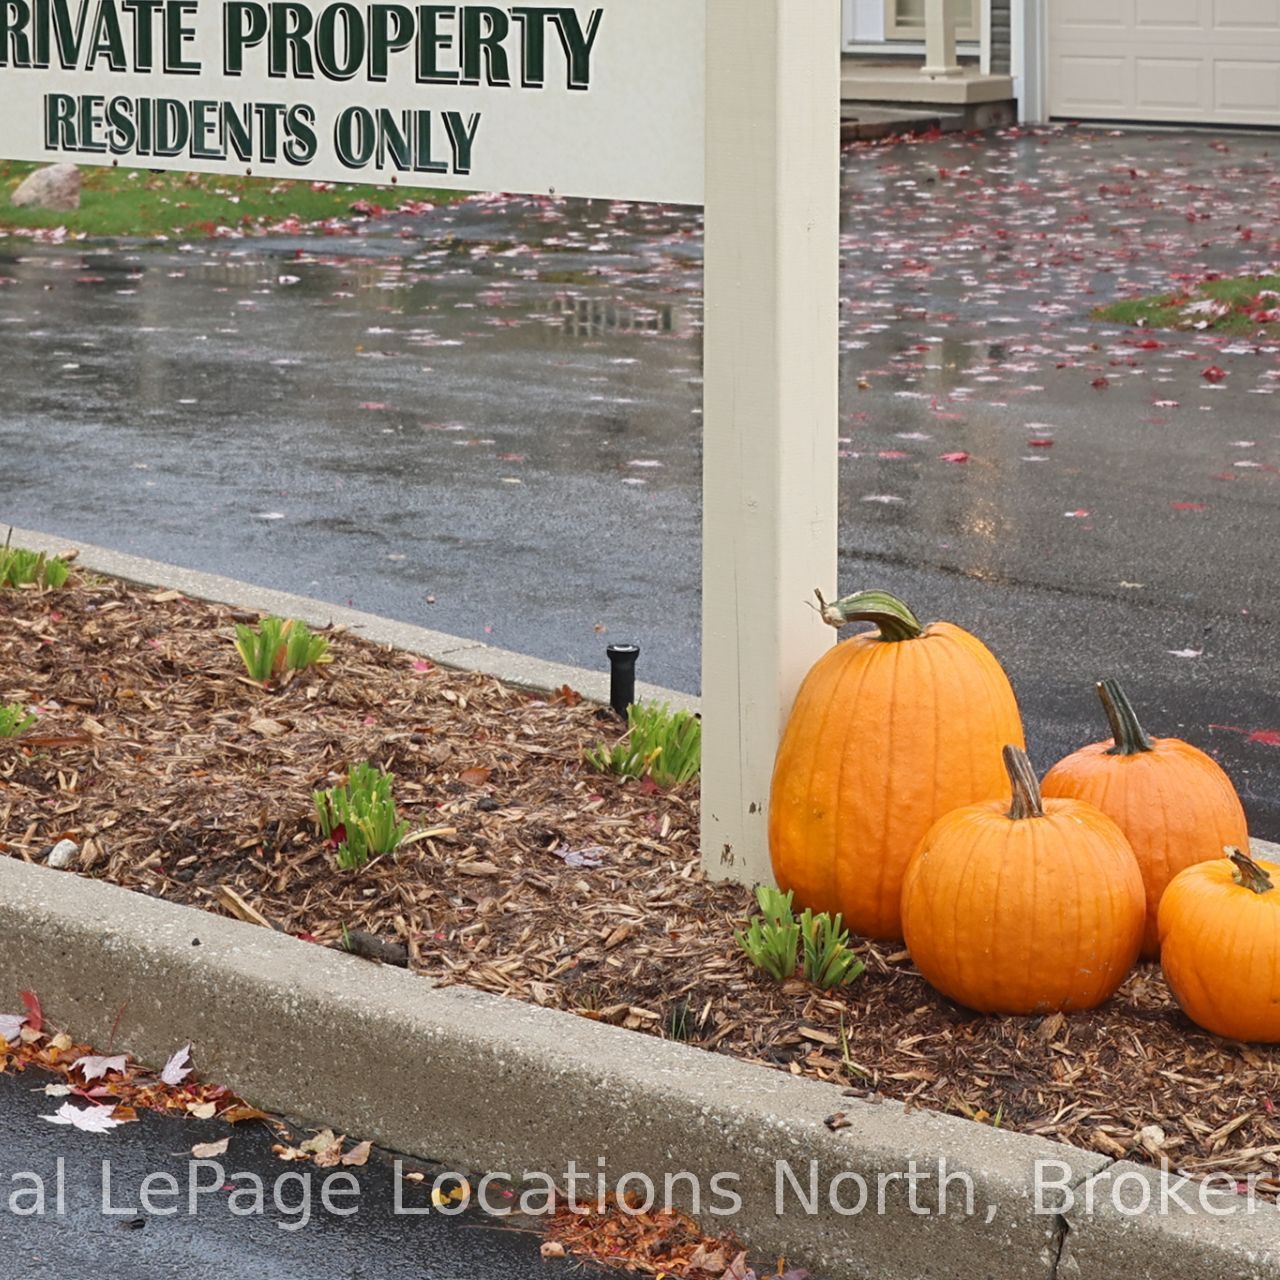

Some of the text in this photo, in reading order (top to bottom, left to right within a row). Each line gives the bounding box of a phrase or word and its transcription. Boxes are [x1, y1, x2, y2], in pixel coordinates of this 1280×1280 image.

[223, 2, 603, 90] PROPERTY
[43, 93, 480, 175] RESIDENTS ONLY
